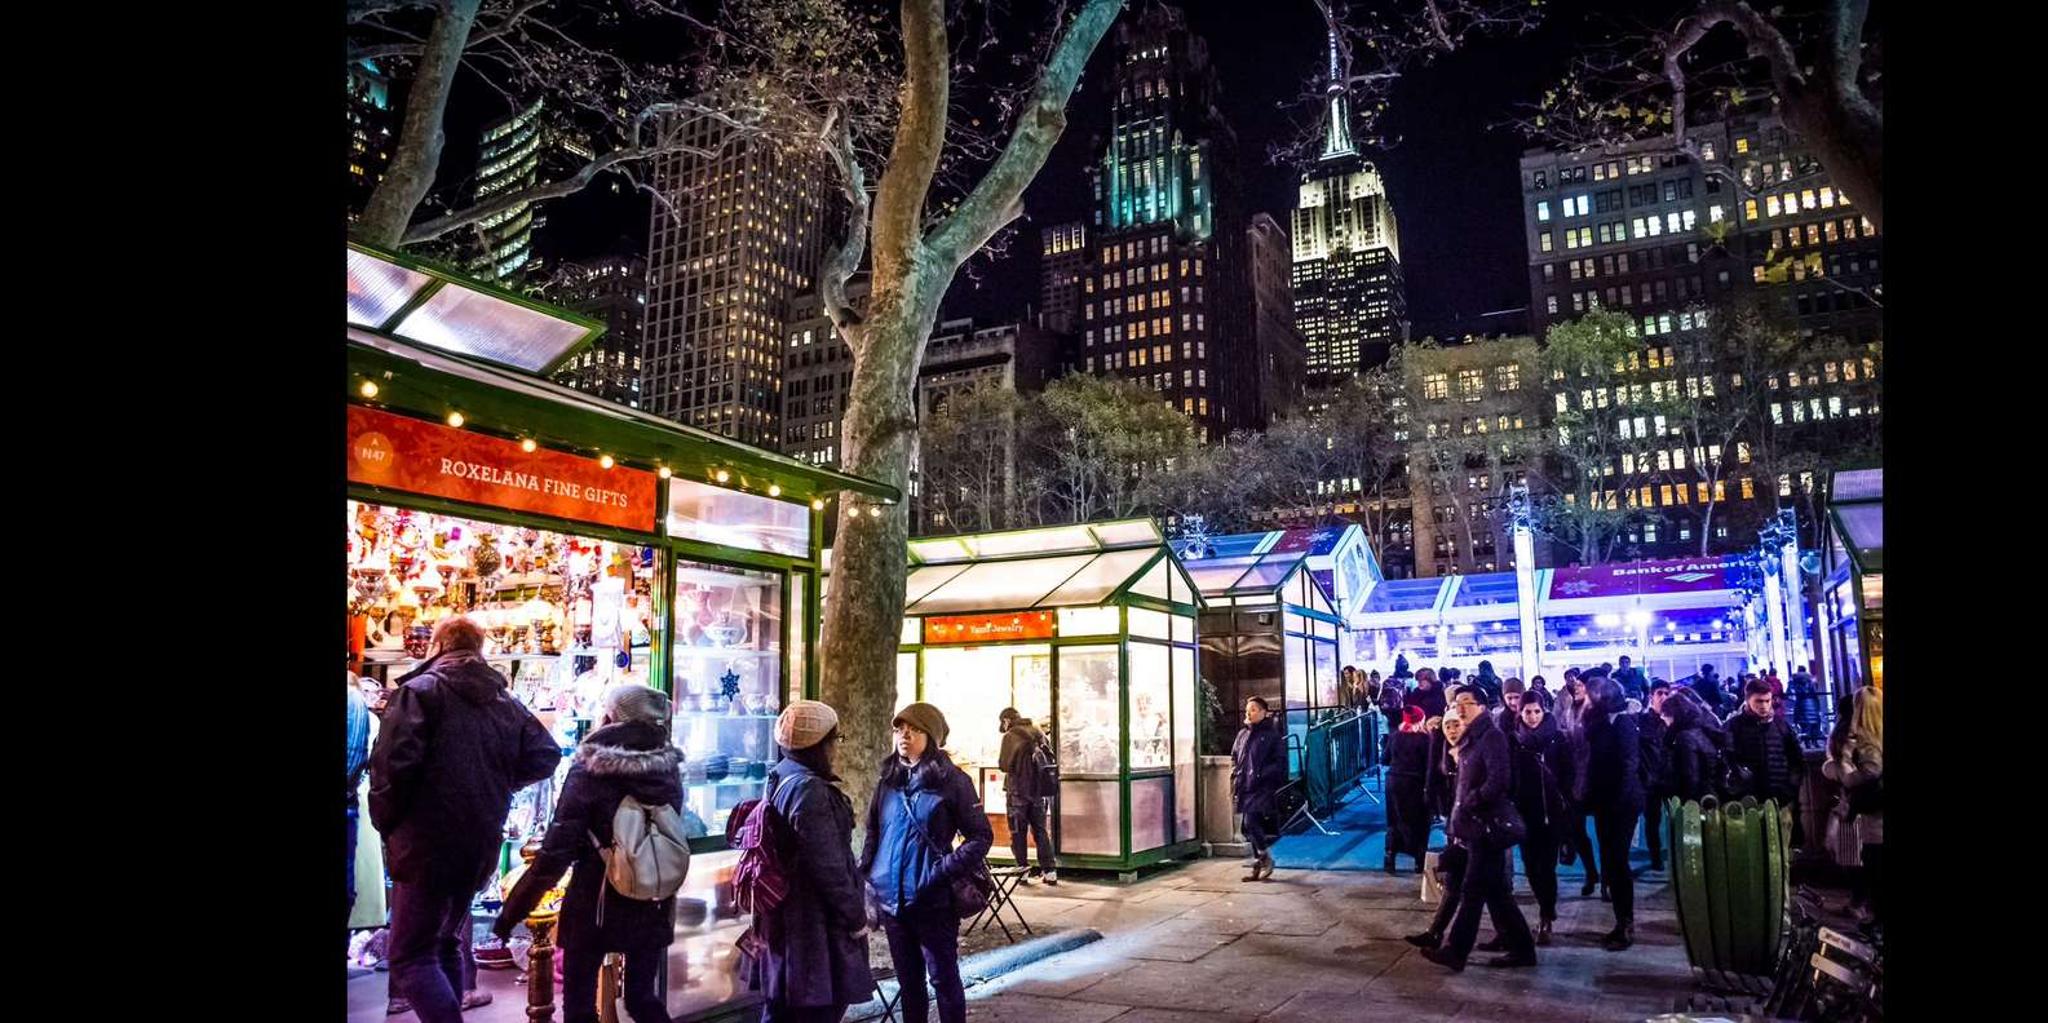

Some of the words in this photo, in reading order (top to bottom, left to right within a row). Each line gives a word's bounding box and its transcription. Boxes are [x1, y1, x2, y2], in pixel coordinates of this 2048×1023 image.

[371, 438, 379, 446] A
[362, 448, 385, 461] N47
[440, 458, 539, 491] ROXELANA
[543, 478, 580, 499] FINE
[584, 487, 628, 508] GIFTS
[1612, 566, 1663, 576] Bank
[1664, 564, 1683, 573] of
[1686, 559, 1757, 571] Americ
